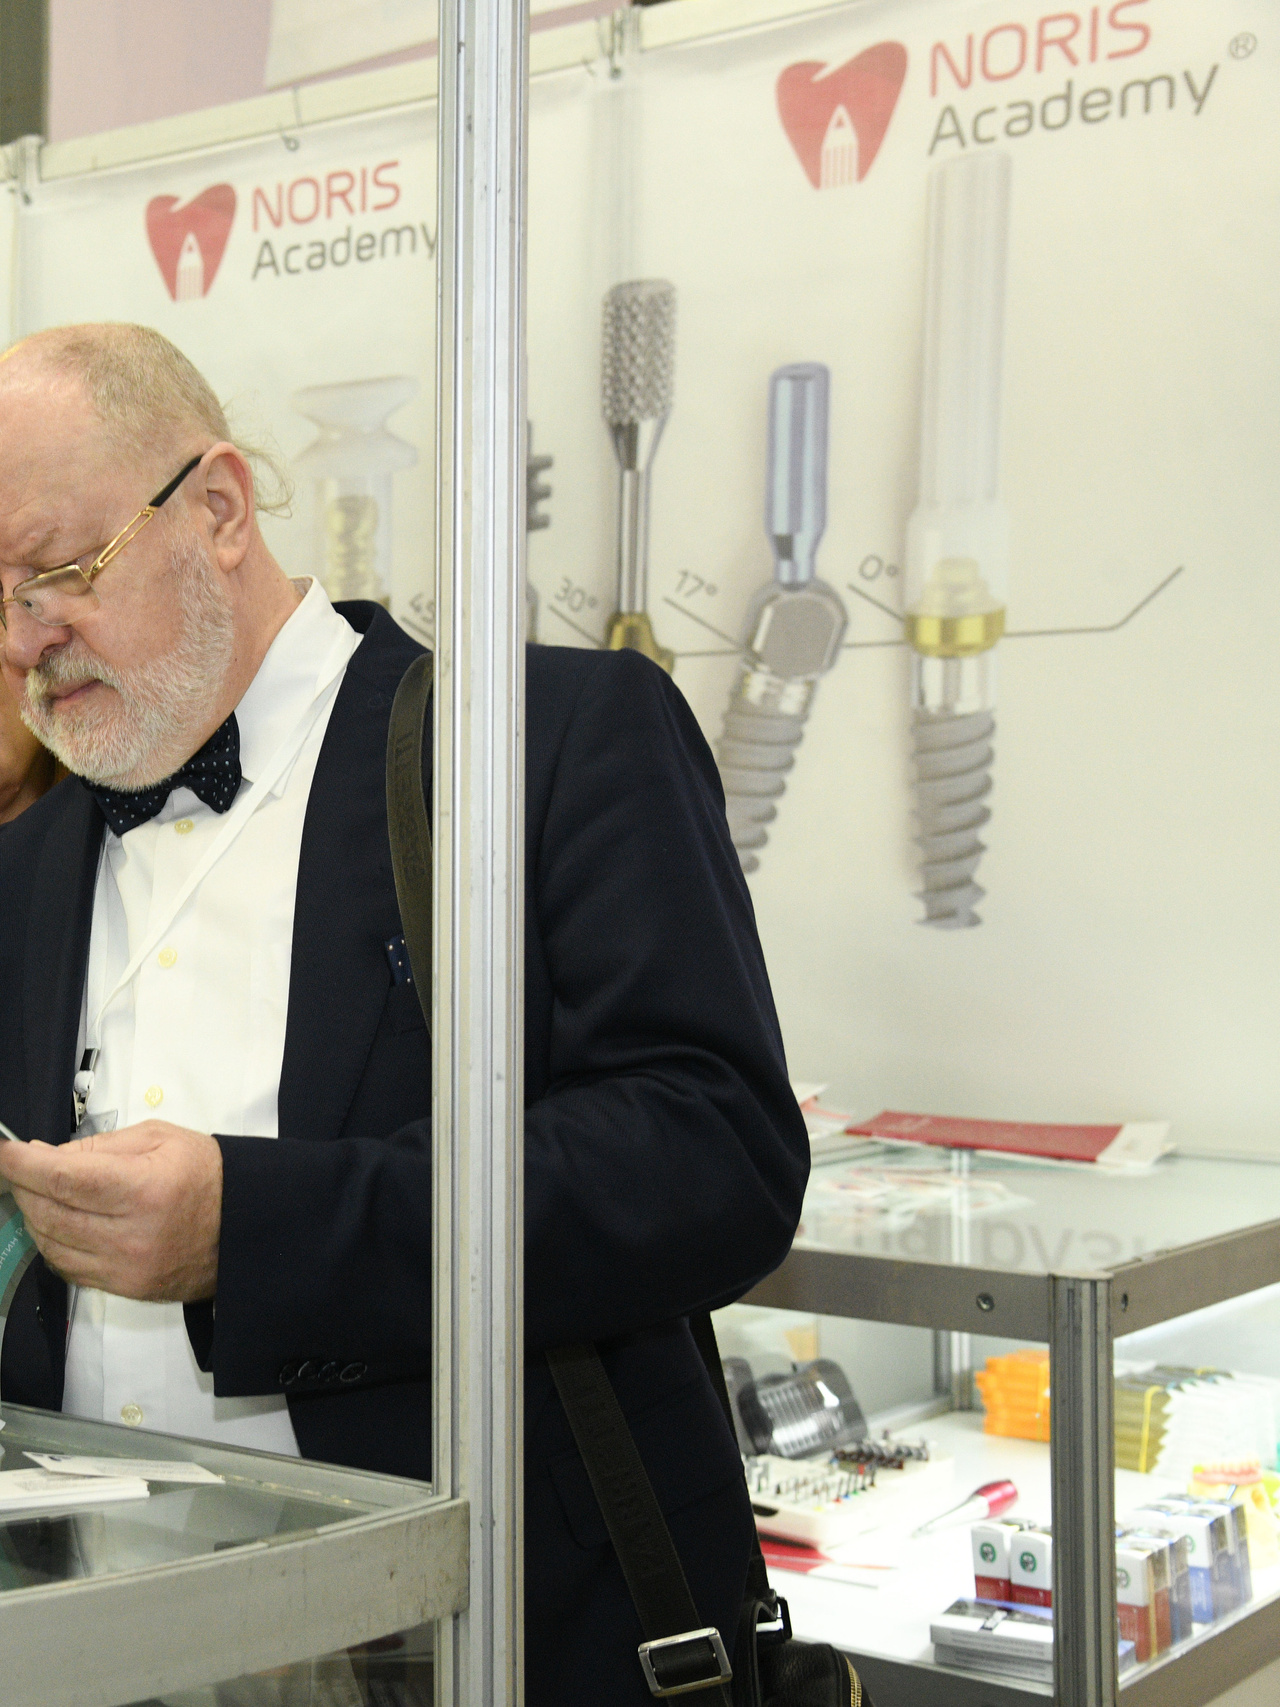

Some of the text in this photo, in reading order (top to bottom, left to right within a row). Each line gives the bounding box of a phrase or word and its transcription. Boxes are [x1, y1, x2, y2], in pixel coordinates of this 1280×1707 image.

[930, 0, 1152, 97] NORIS
[927, 63, 1220, 157] Academy
[252, 160, 401, 232] NORIS
[251, 222, 437, 281] Academy
[673, 568, 718, 599] 17°
